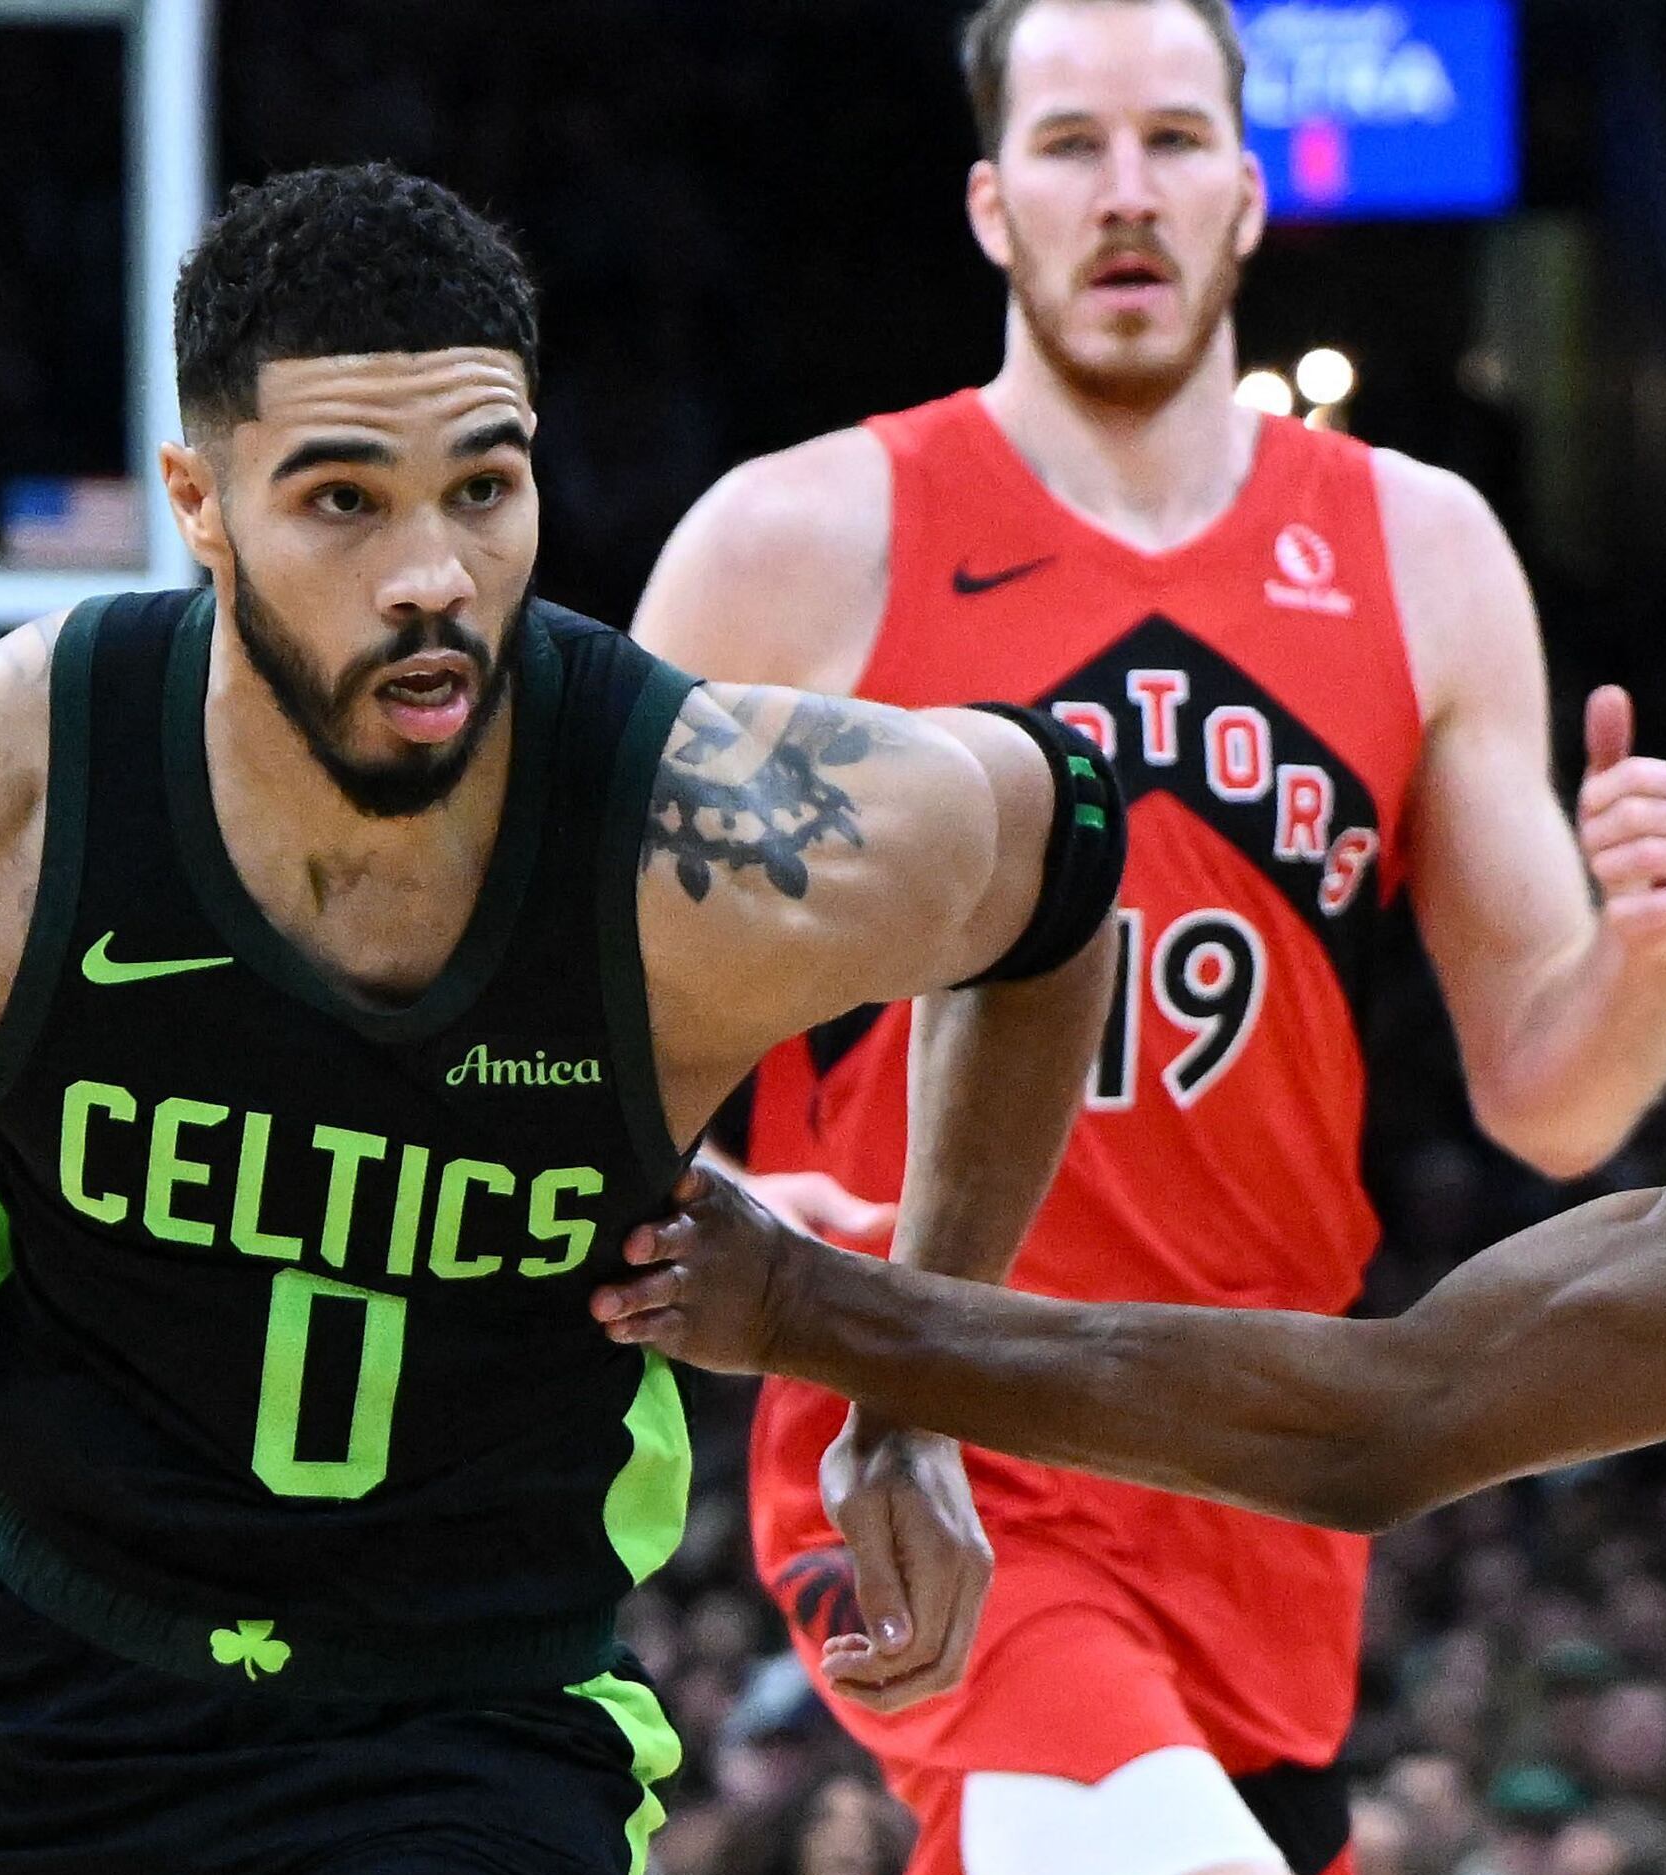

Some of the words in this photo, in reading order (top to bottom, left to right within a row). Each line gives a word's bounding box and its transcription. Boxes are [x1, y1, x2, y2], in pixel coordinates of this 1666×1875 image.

[444, 1043, 602, 1088] Amica
[1083, 907, 1269, 1113] 19
[59, 1079, 605, 1281] CELTICS
[250, 1266, 409, 1501] 0
